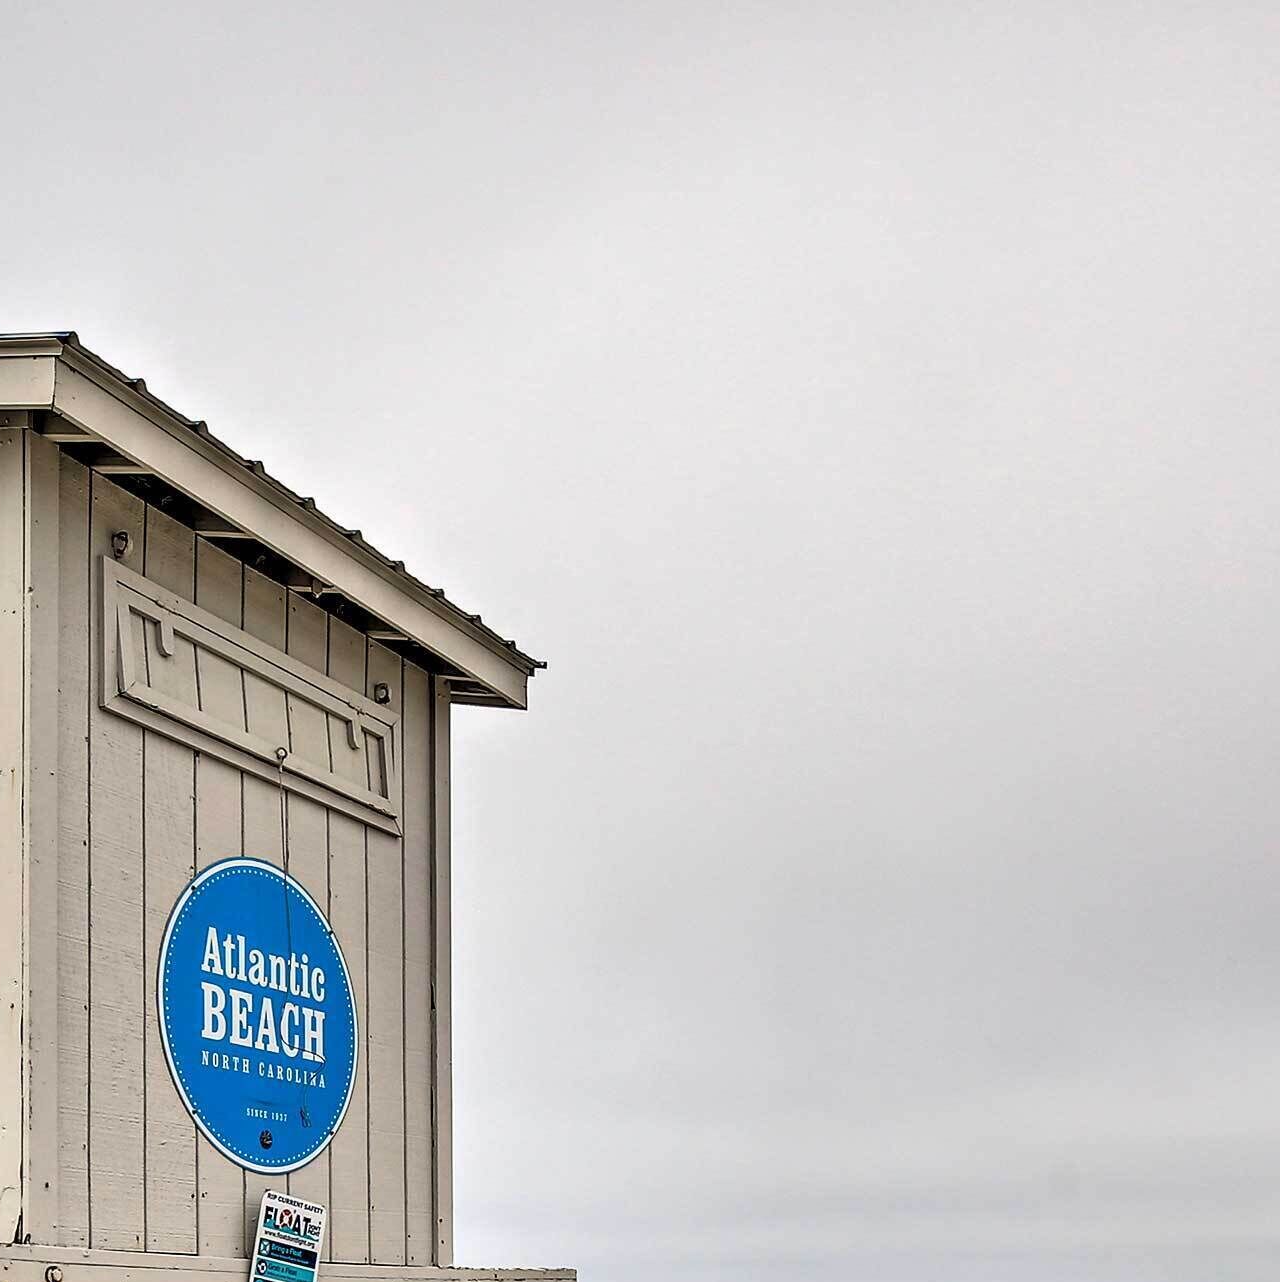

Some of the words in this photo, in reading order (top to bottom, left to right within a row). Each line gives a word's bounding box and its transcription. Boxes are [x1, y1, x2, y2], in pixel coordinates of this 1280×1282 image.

[201, 926, 325, 1001] Atlantic
[201, 981, 326, 1064] BEACH
[201, 1051, 250, 1074] NORTH
[259, 1062, 326, 1088] CAROLINA
[246, 1107, 268, 1119] SINCE
[267, 1192, 277, 1201] RIP
[278, 1196, 304, 1208] CURRENT
[304, 1204, 323, 1215] SAFETY
[263, 1205, 311, 1237] FLOAT
